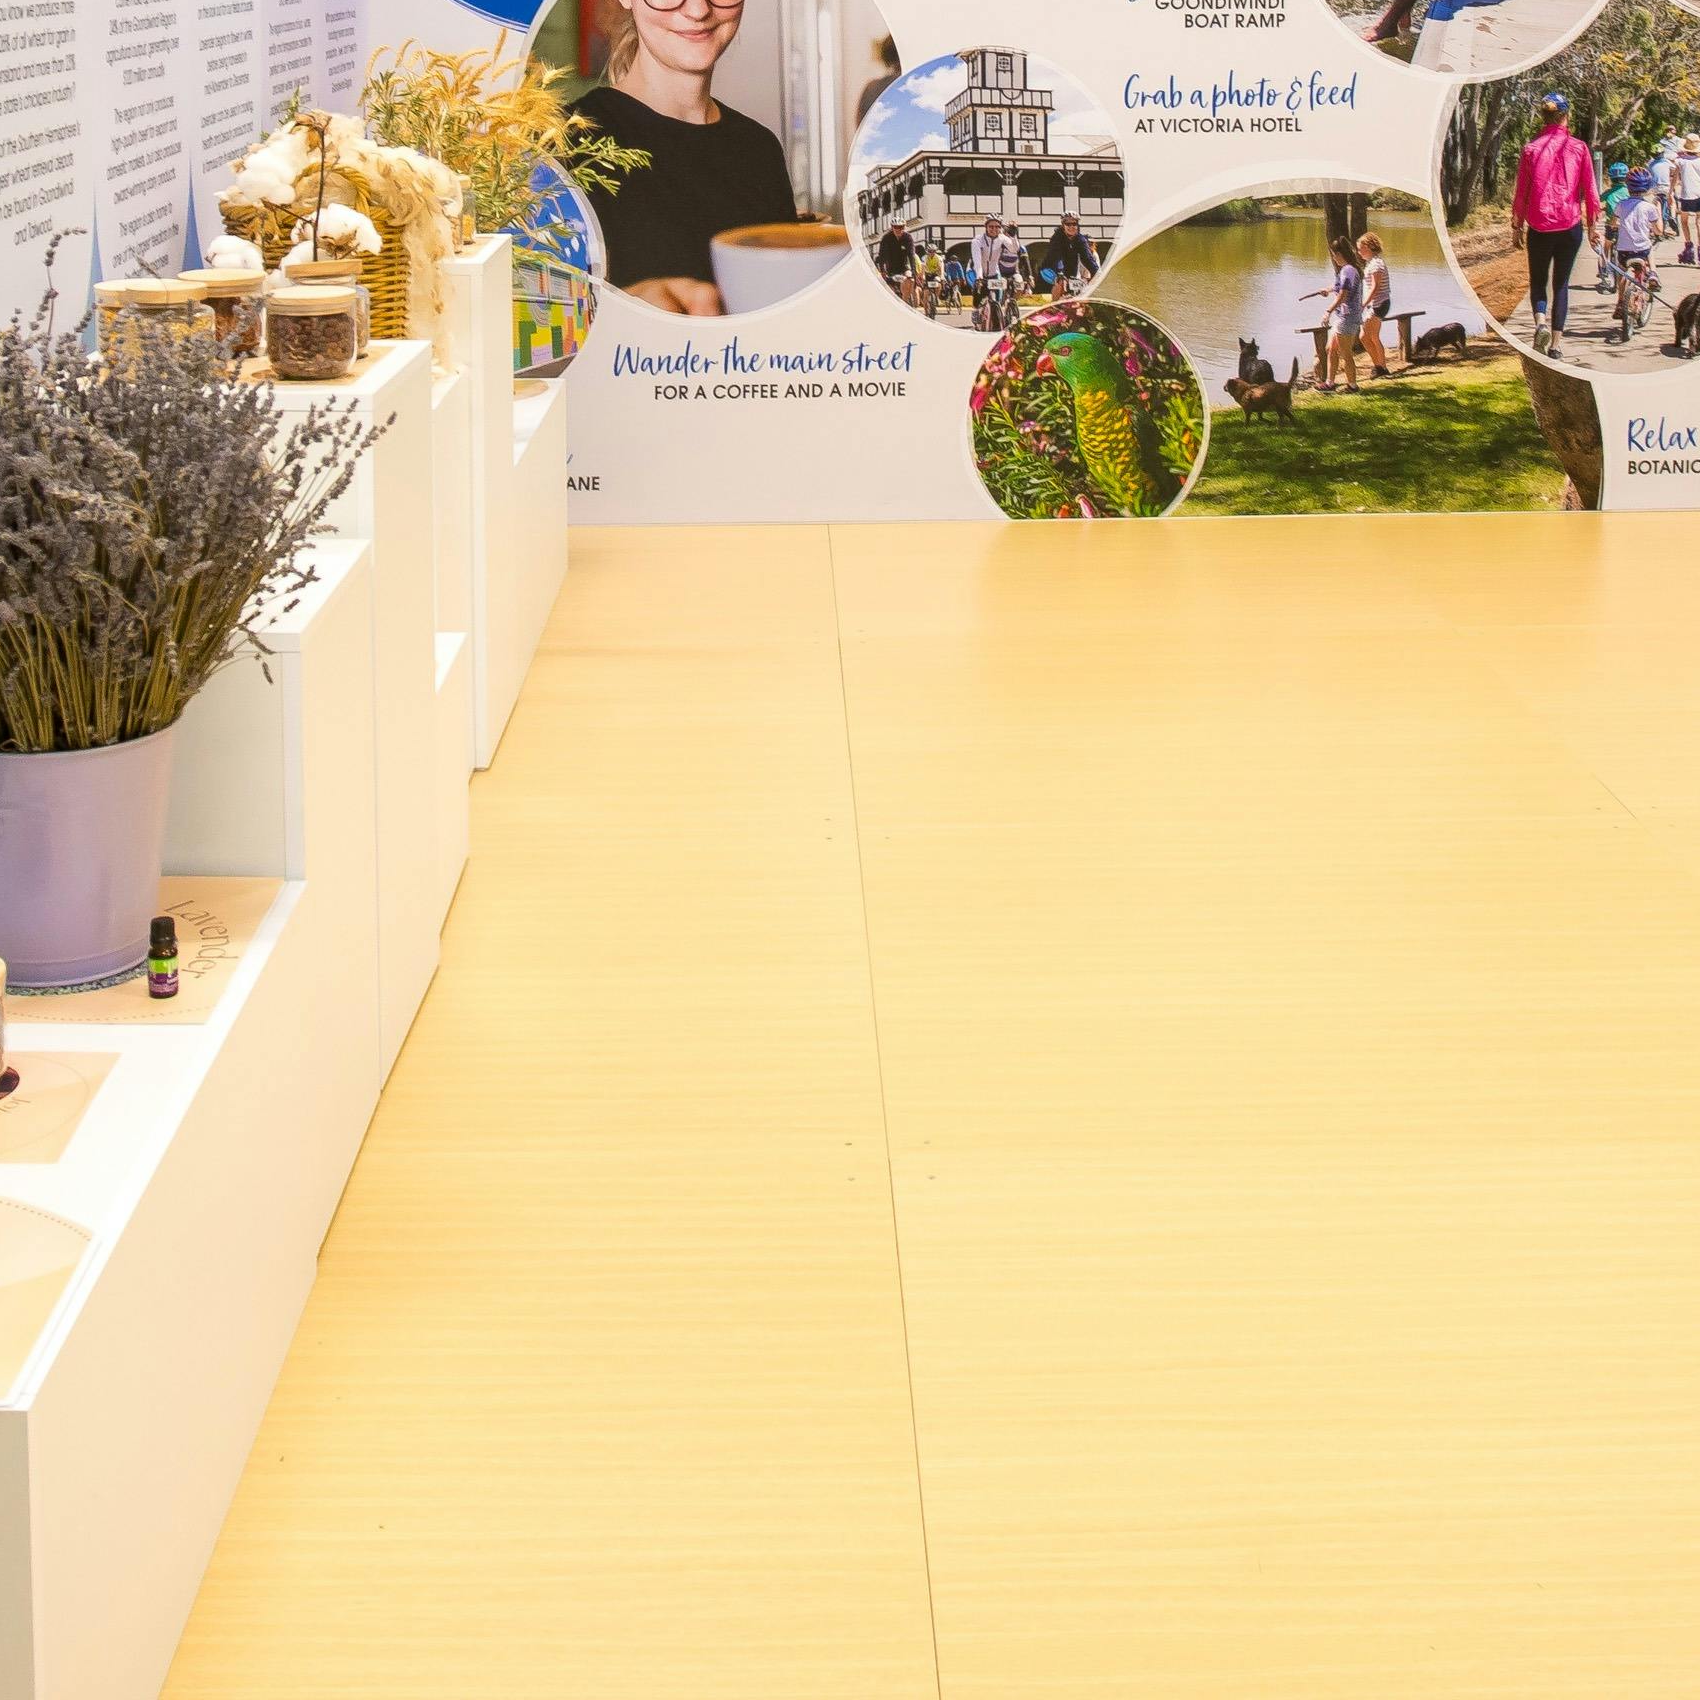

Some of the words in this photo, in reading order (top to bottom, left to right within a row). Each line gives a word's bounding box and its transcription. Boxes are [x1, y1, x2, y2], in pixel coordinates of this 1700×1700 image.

[1185, 14, 1229, 28] BOAT
[1236, 14, 1285, 27] RAMP
[1125, 74, 1182, 109] Grab
[1190, 90, 1205, 108] a
[1212, 70, 1280, 118] photo
[1309, 71, 1356, 111] feed
[1135, 119, 1154, 133] AT
[1160, 119, 1244, 132] VICTORIA
[1251, 118, 1302, 132] HOTEL
[614, 340, 718, 378] Wander
[721, 336, 765, 374] the
[770, 353, 835, 373] main
[843, 342, 913, 374] street
[655, 386, 688, 400] FOR
[694, 385, 707, 399] A
[713, 384, 778, 399] COFFEE
[785, 384, 823, 398] AND
[830, 383, 842, 397] A
[849, 382, 905, 397] MOVIE
[1628, 417, 1696, 452] Relax
[567, 477, 600, 491] ANE
[164, 899, 239, 980] Lavender
